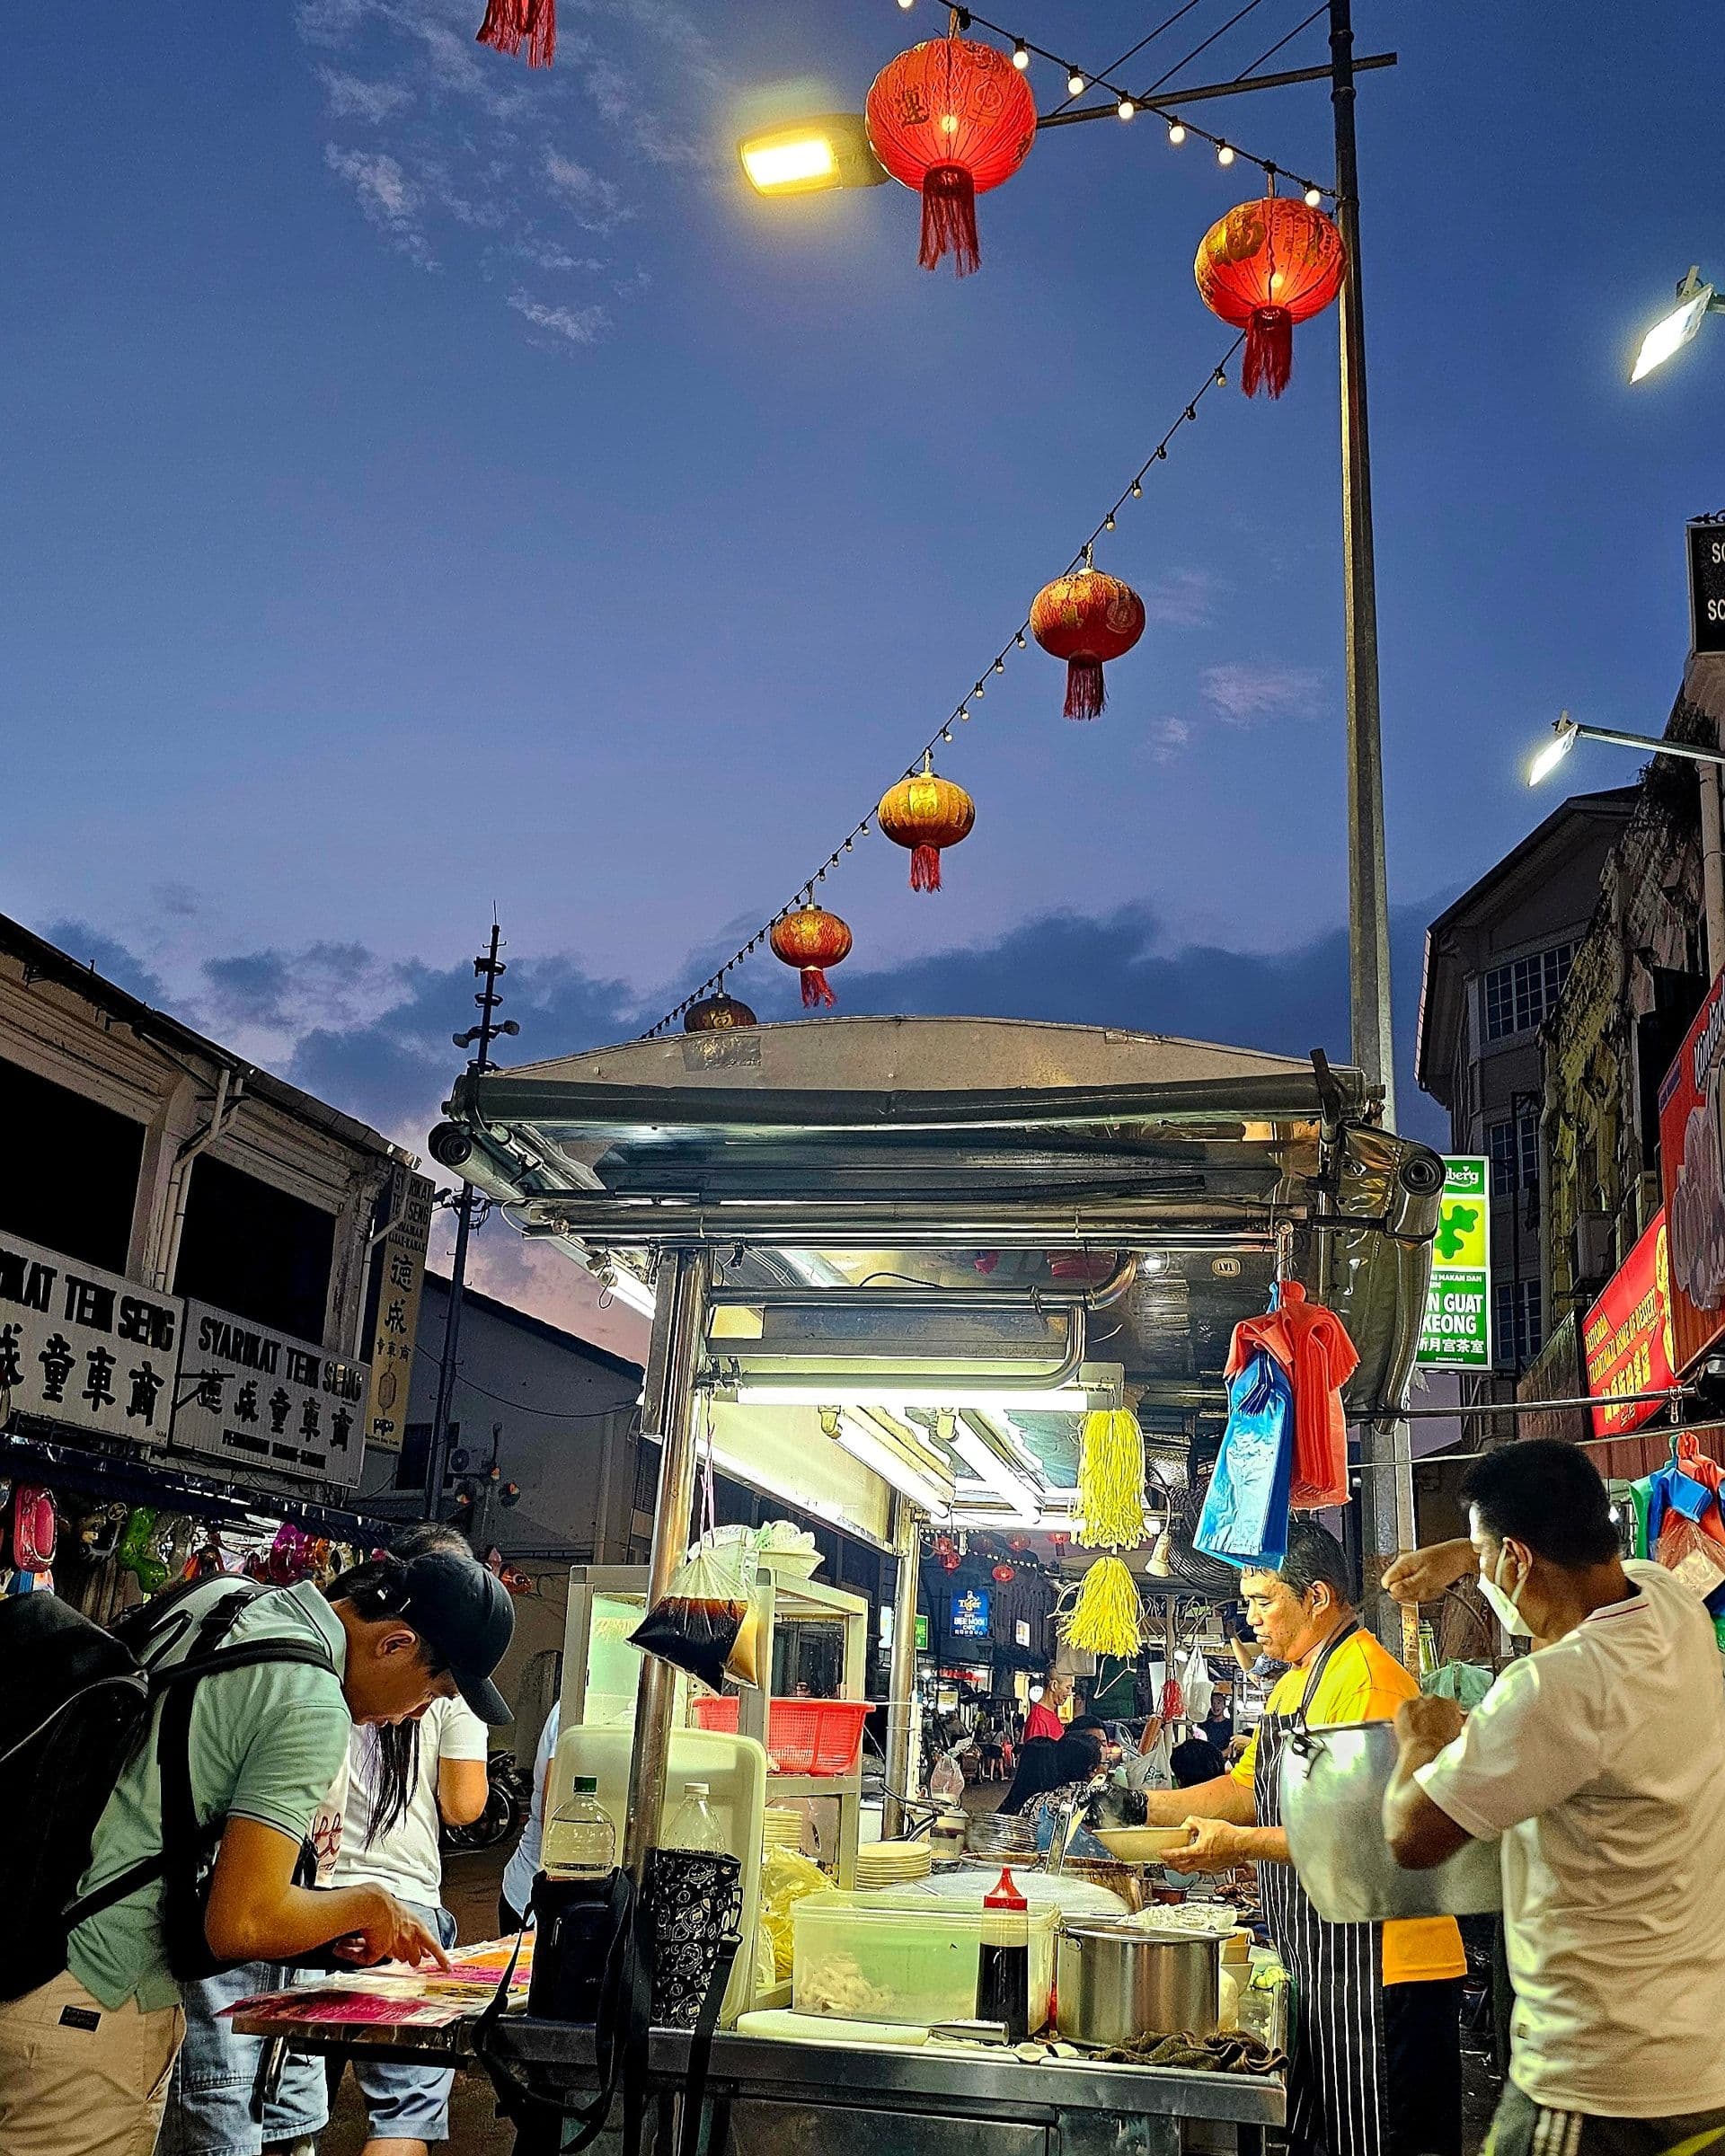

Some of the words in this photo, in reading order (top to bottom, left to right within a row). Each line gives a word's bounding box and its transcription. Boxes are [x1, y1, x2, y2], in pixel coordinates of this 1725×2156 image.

[1443, 1293, 1483, 1313] GUAT
[118, 1294, 176, 1353] SENG
[1422, 1313, 1477, 1335] KEONG
[198, 1315, 282, 1375] SYARIKAT
[322, 1360, 364, 1402] SENG
